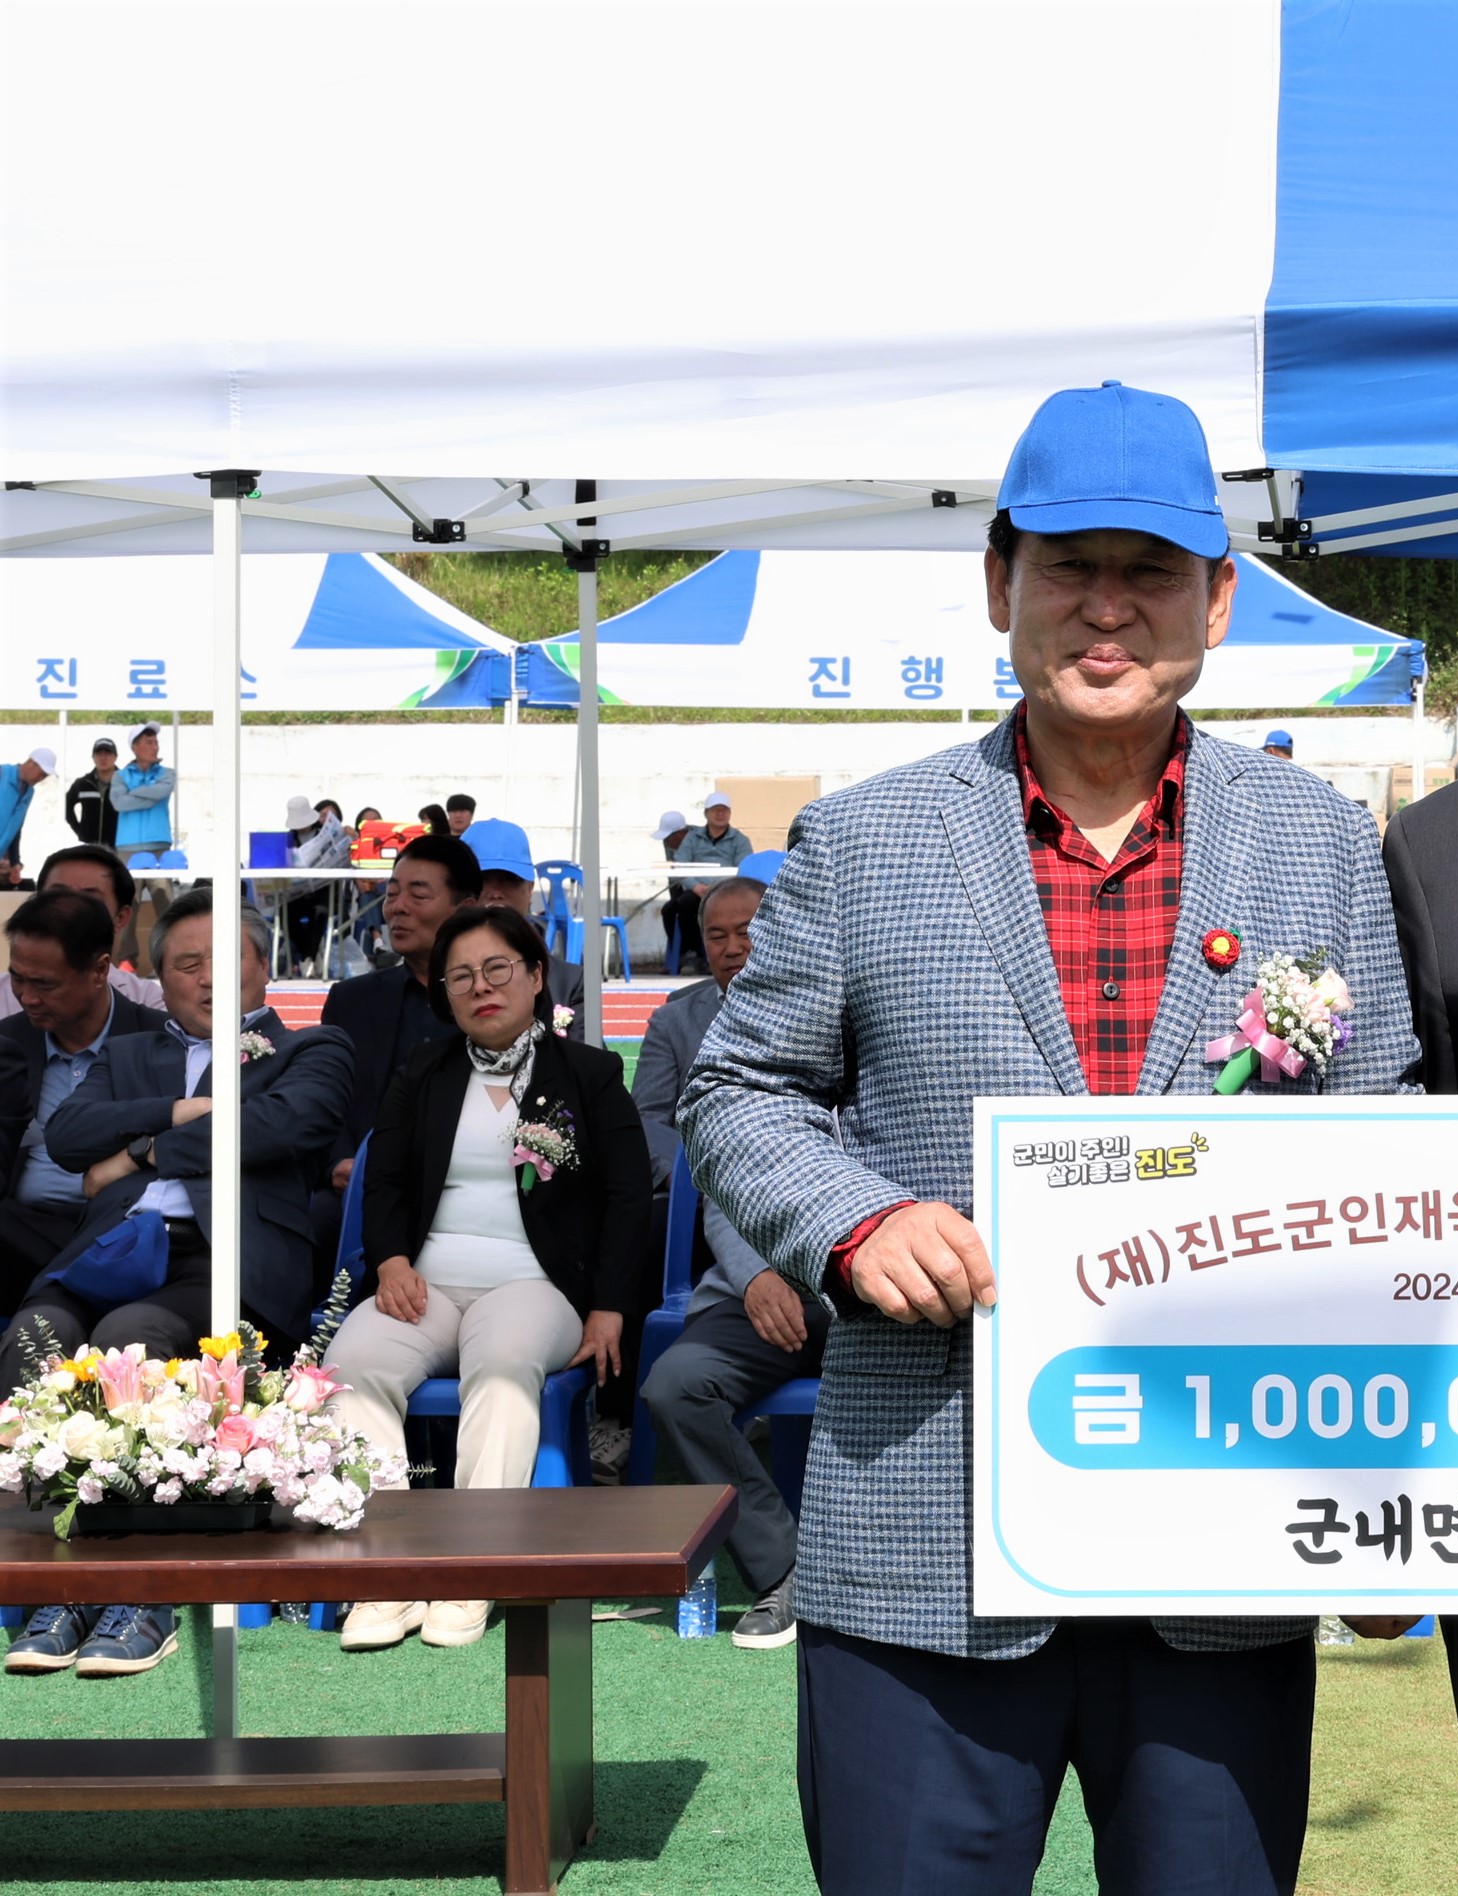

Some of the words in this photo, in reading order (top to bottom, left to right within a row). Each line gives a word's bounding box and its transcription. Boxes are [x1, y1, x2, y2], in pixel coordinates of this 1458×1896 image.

[1013, 1140, 1076, 1166] 군민이
[1080, 1135, 1130, 1161] 주인!
[1047, 1159, 1130, 1187] 살기좋은
[1134, 1145, 1197, 1180] 진도
[1072, 1373, 1143, 1445] 금
